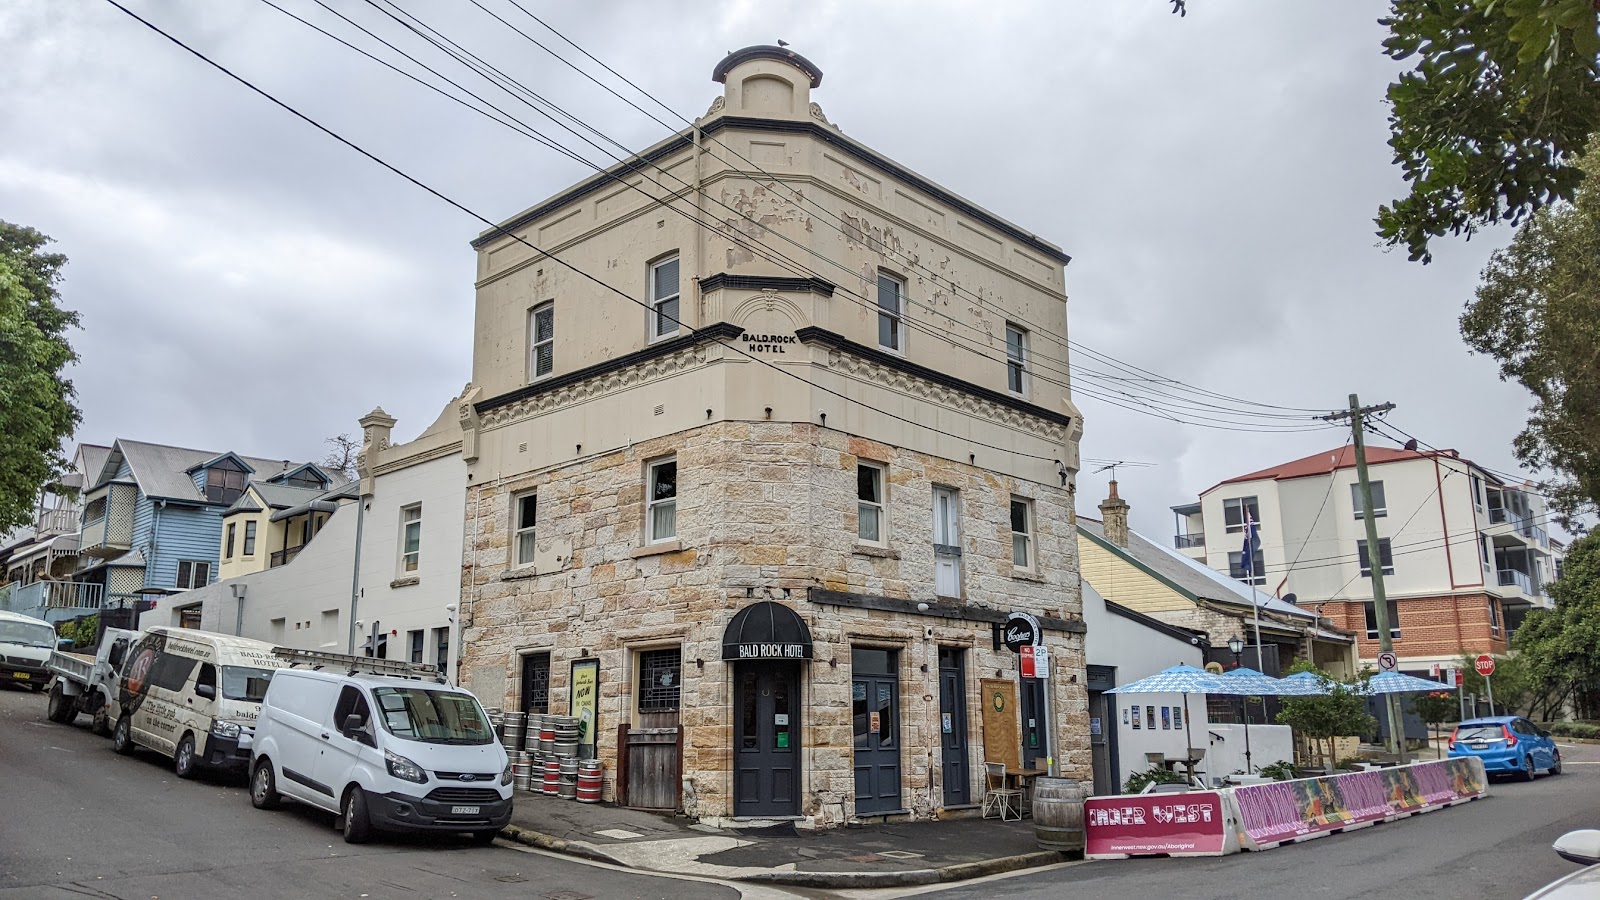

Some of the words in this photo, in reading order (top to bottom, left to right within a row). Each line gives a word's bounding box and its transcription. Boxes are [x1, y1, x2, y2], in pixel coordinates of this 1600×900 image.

[749, 343, 785, 353] HOTEL
[1007, 626, 1031, 642] Coopers
[239, 650, 263, 659] BALD
[739, 644, 759, 658] BALD
[760, 643, 783, 657] ROCK
[784, 644, 804, 658] HOTEL
[1035, 649, 1047, 657] 2P
[252, 658, 283, 669] HOTEL
[1476, 660, 1493, 670] STOP
[575, 685, 592, 700] NOW
[152, 717, 160, 727] the
[1089, 806, 1147, 826] INNER
[1152, 803, 1213, 824] WEST
[1110, 842, 1195, 851] innerwest.nsw.gov.au/Aboriginal
